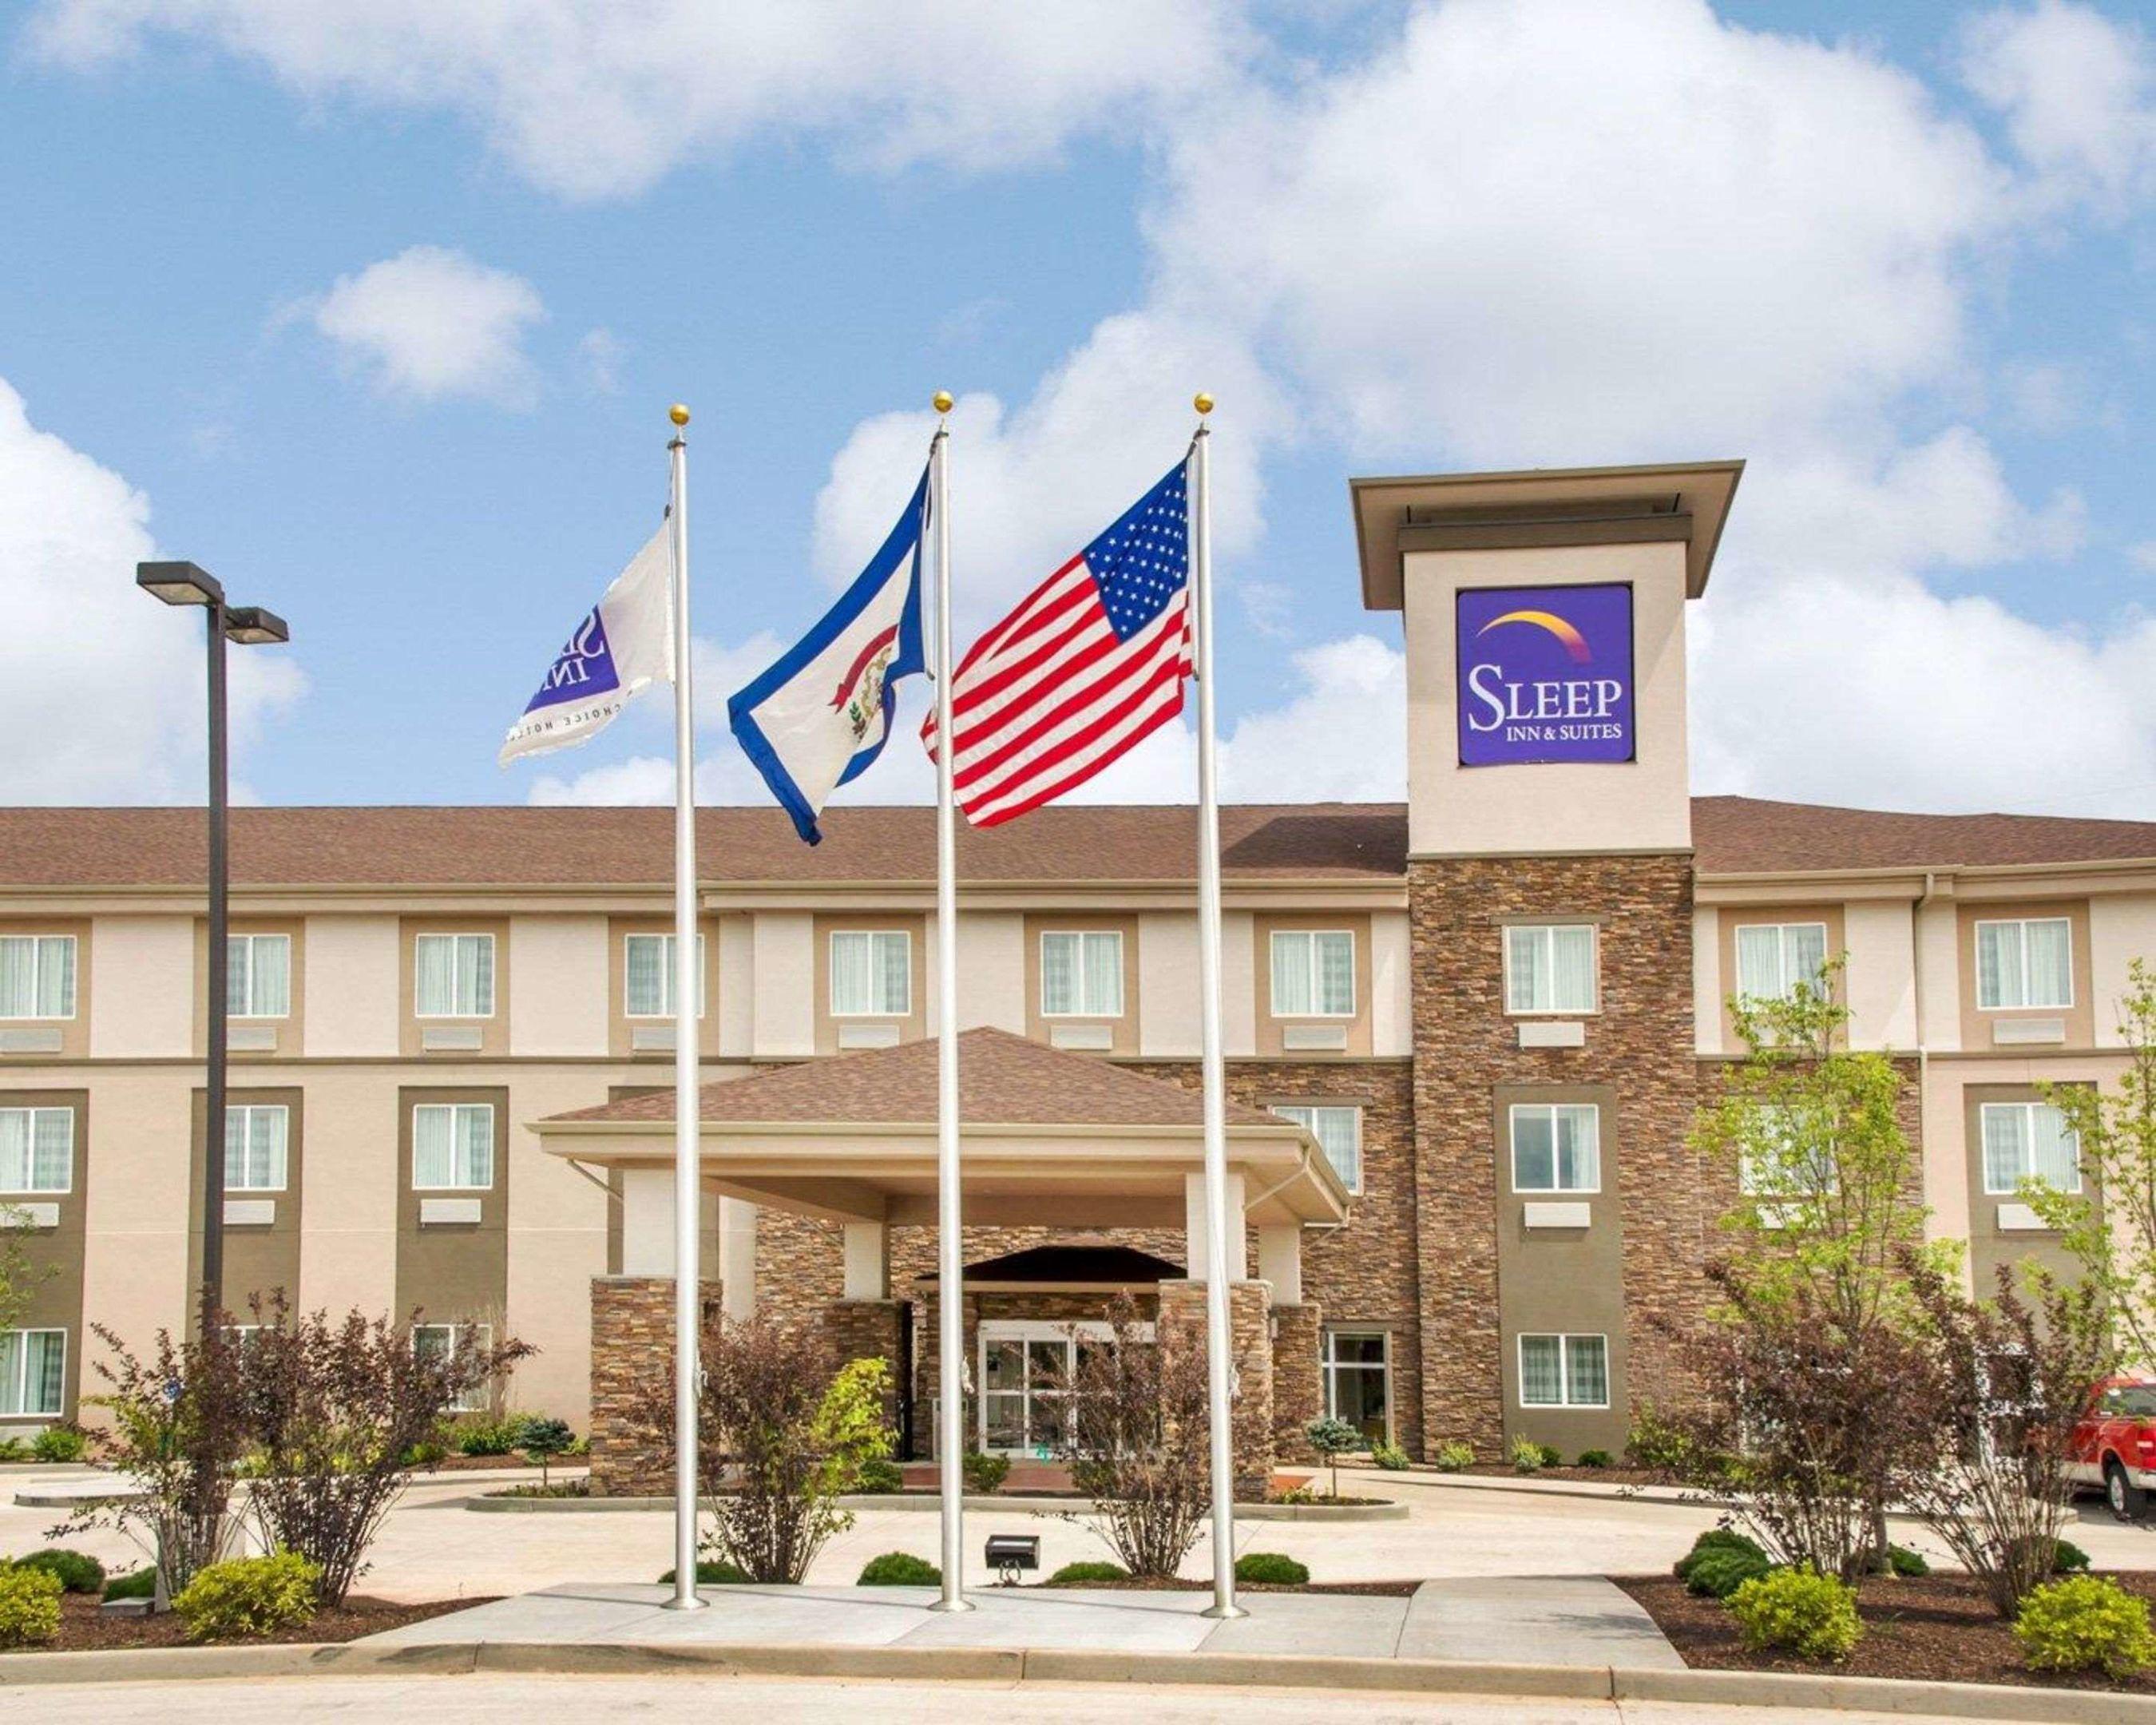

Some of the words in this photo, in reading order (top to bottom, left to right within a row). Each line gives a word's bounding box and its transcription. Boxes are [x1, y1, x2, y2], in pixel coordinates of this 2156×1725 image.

[1468, 664, 1623, 732] SLEEP
[1507, 726, 1541, 742] INN
[1544, 726, 1556, 740] &
[1560, 724, 1623, 740] SUITES
